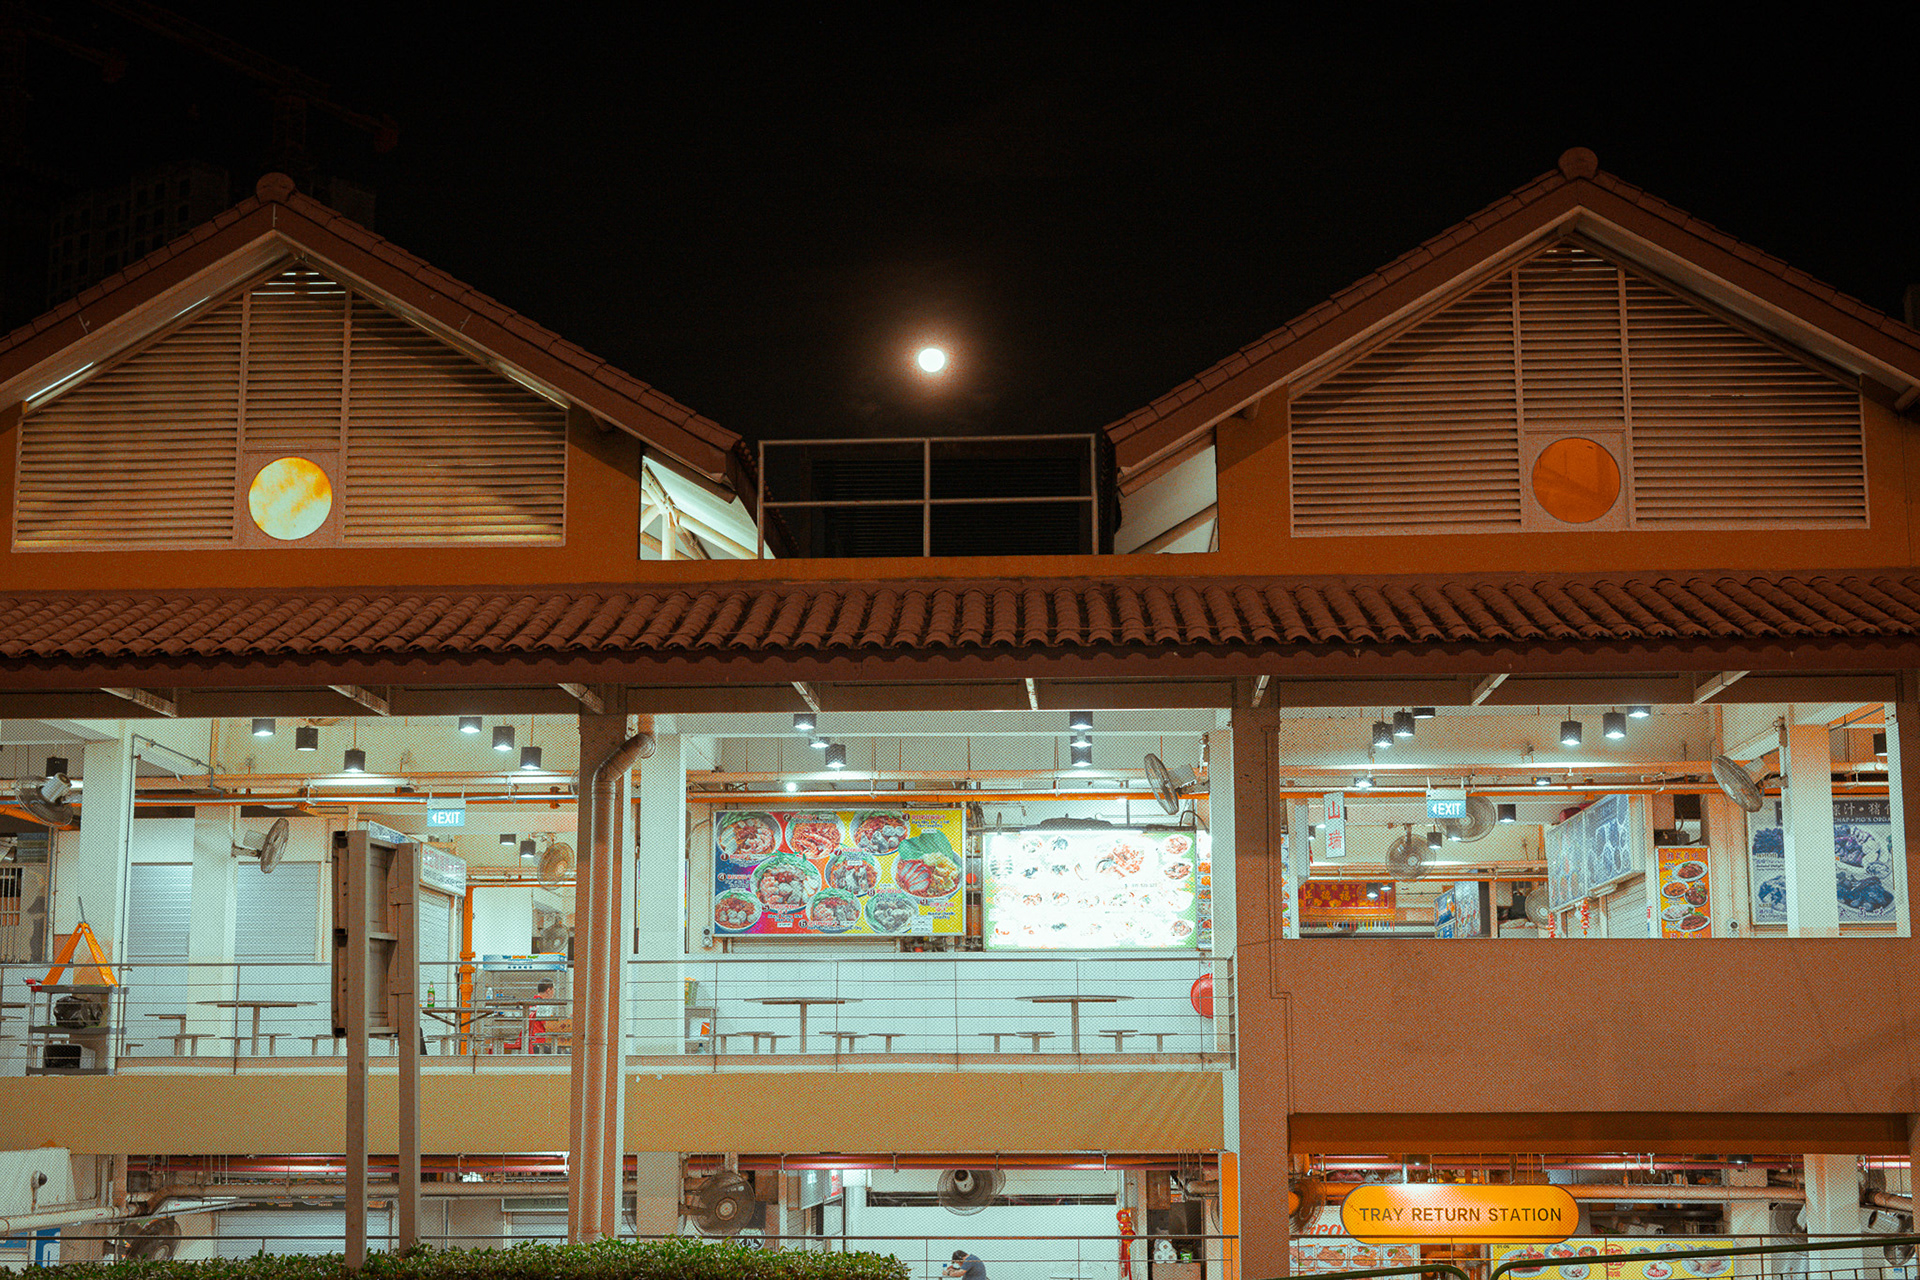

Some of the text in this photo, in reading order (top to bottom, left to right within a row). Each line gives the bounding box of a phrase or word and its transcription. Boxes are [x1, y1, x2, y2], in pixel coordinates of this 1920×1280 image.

[1438, 803, 1461, 815] EXIT
[438, 812, 460, 824] EXIT
[1328, 801, 1342, 849] 山瑞
[1359, 1208, 1562, 1221] TRAY RETURN STATION
